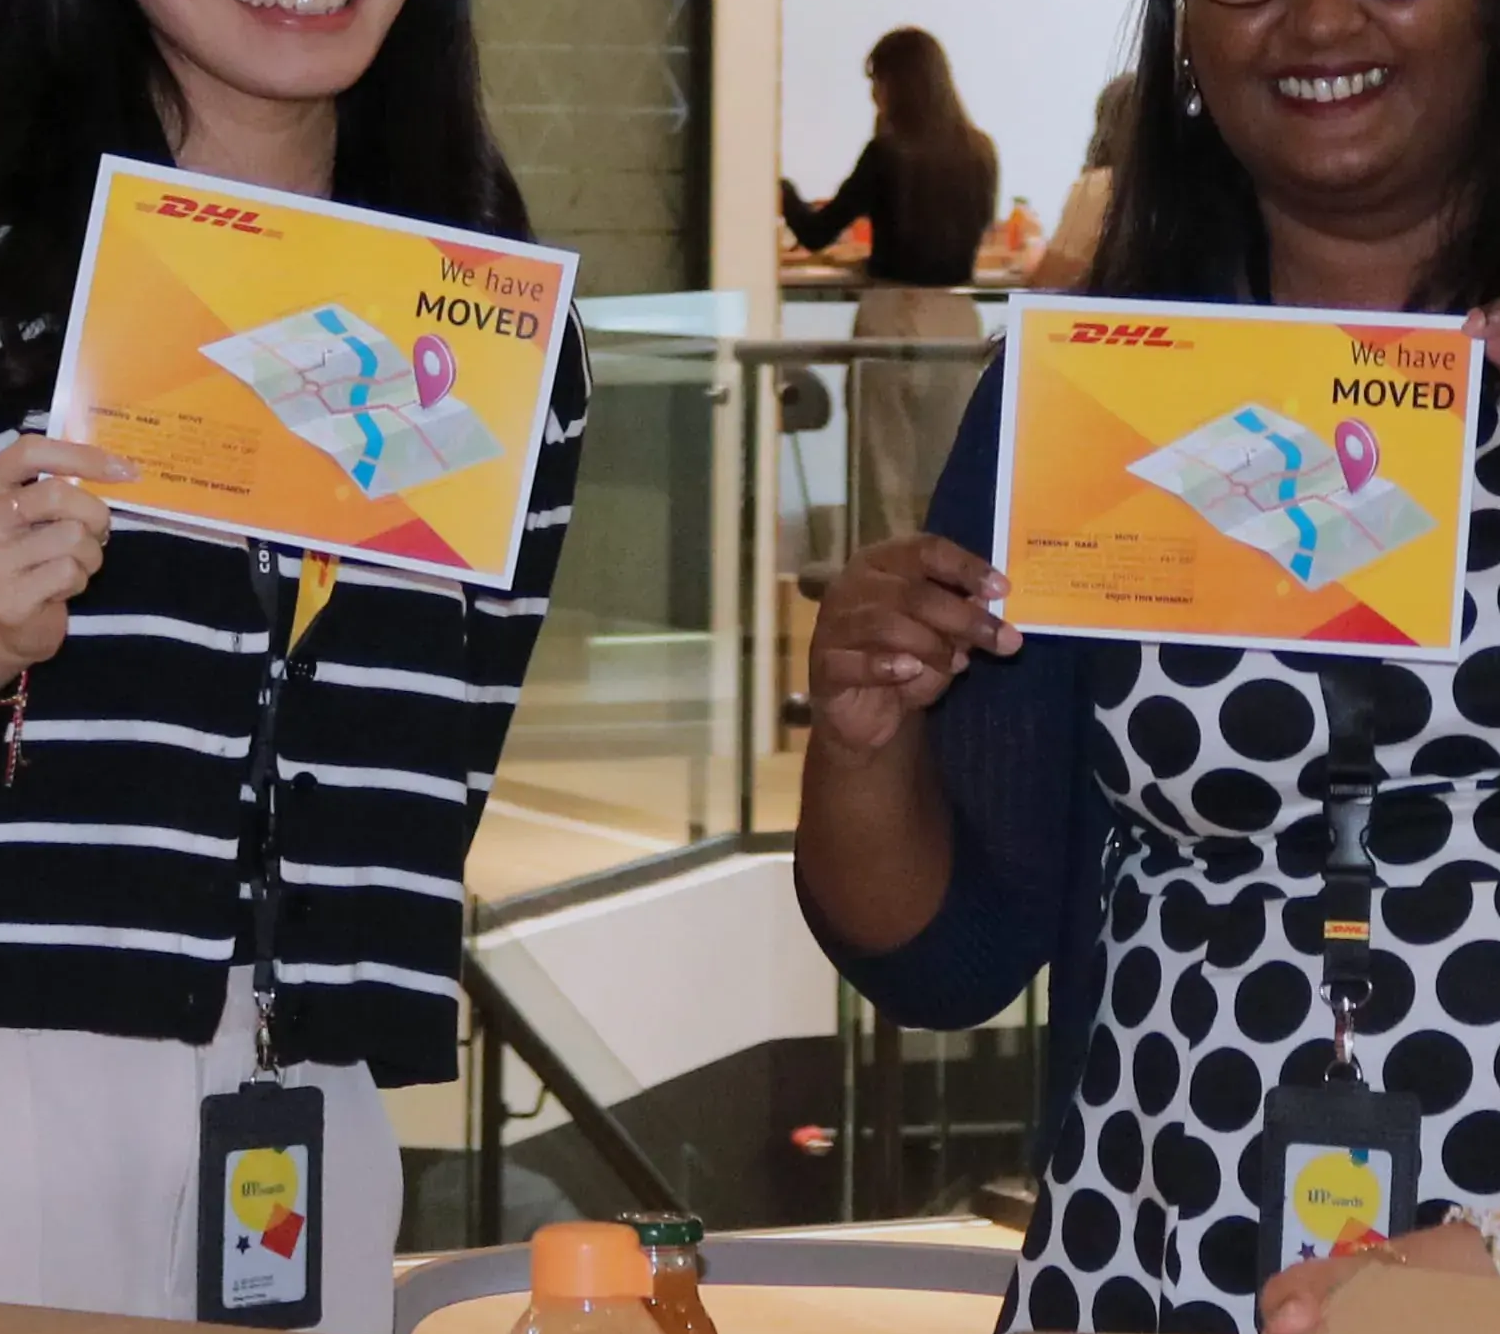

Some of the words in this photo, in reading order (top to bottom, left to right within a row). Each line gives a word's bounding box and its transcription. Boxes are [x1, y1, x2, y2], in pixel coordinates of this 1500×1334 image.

[154, 193, 268, 235] DHL
[440, 257, 476, 287] We
[486, 266, 545, 301] have
[416, 291, 539, 340] MOVED
[1070, 322, 1174, 349] DHL
[1351, 341, 1386, 366] We
[1397, 344, 1455, 370] have
[1332, 378, 1455, 410] MOVED
